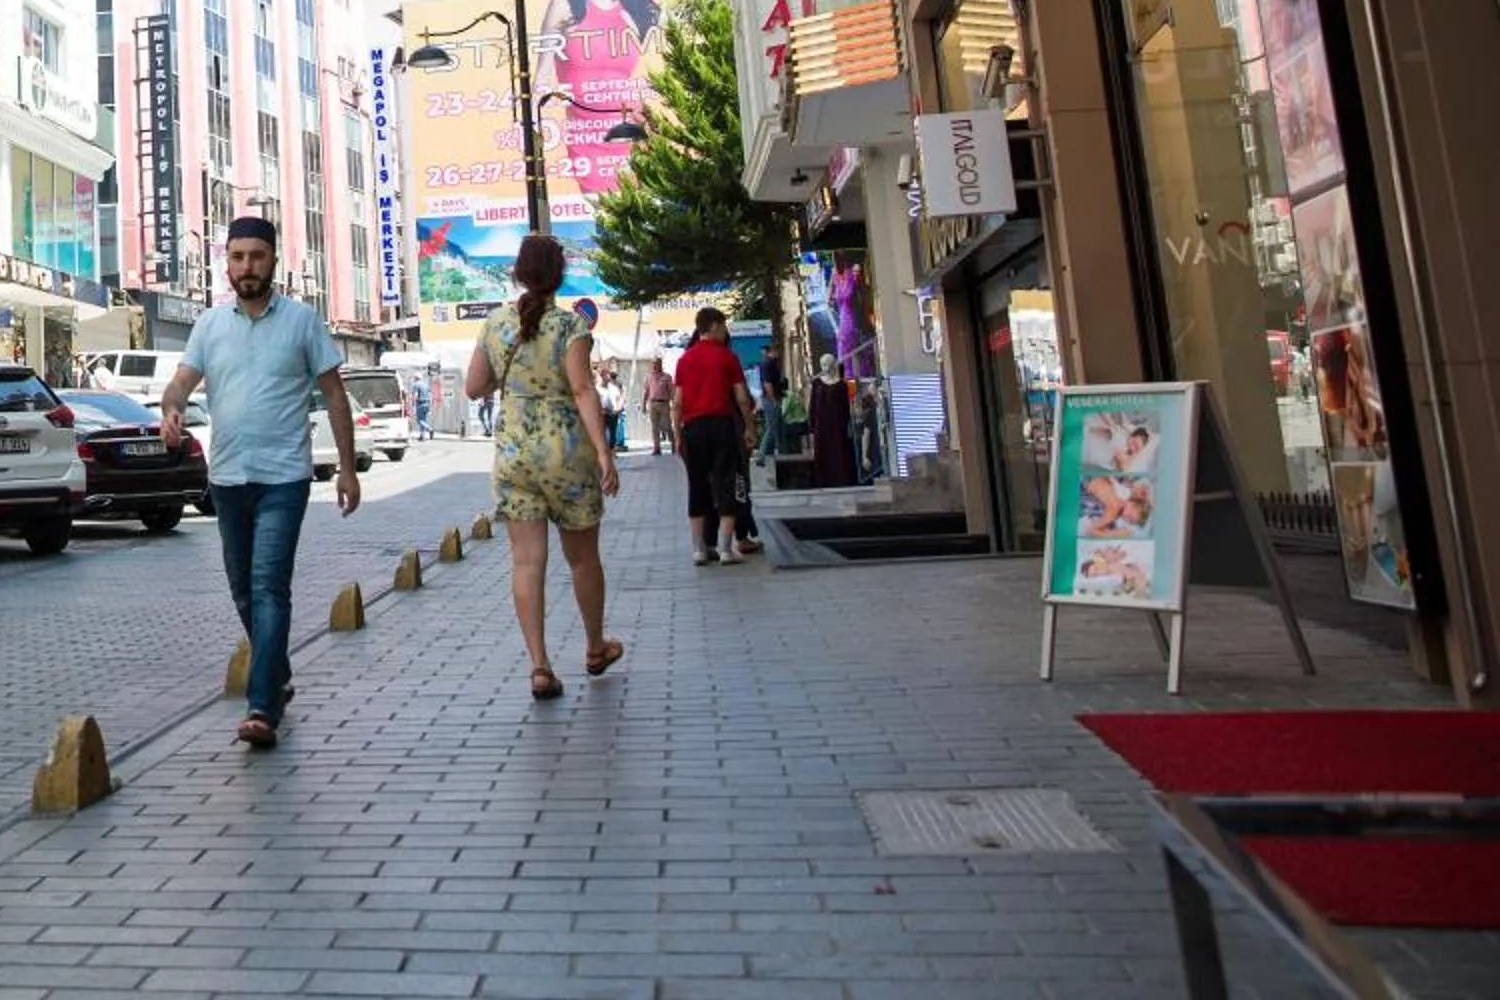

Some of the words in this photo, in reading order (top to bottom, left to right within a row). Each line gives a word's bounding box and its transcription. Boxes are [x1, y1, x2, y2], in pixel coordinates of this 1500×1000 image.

[153, 30, 168, 131] METROPOL
[371, 49, 387, 141] MEGAPOL
[476, 206, 528, 221] LIBERT
